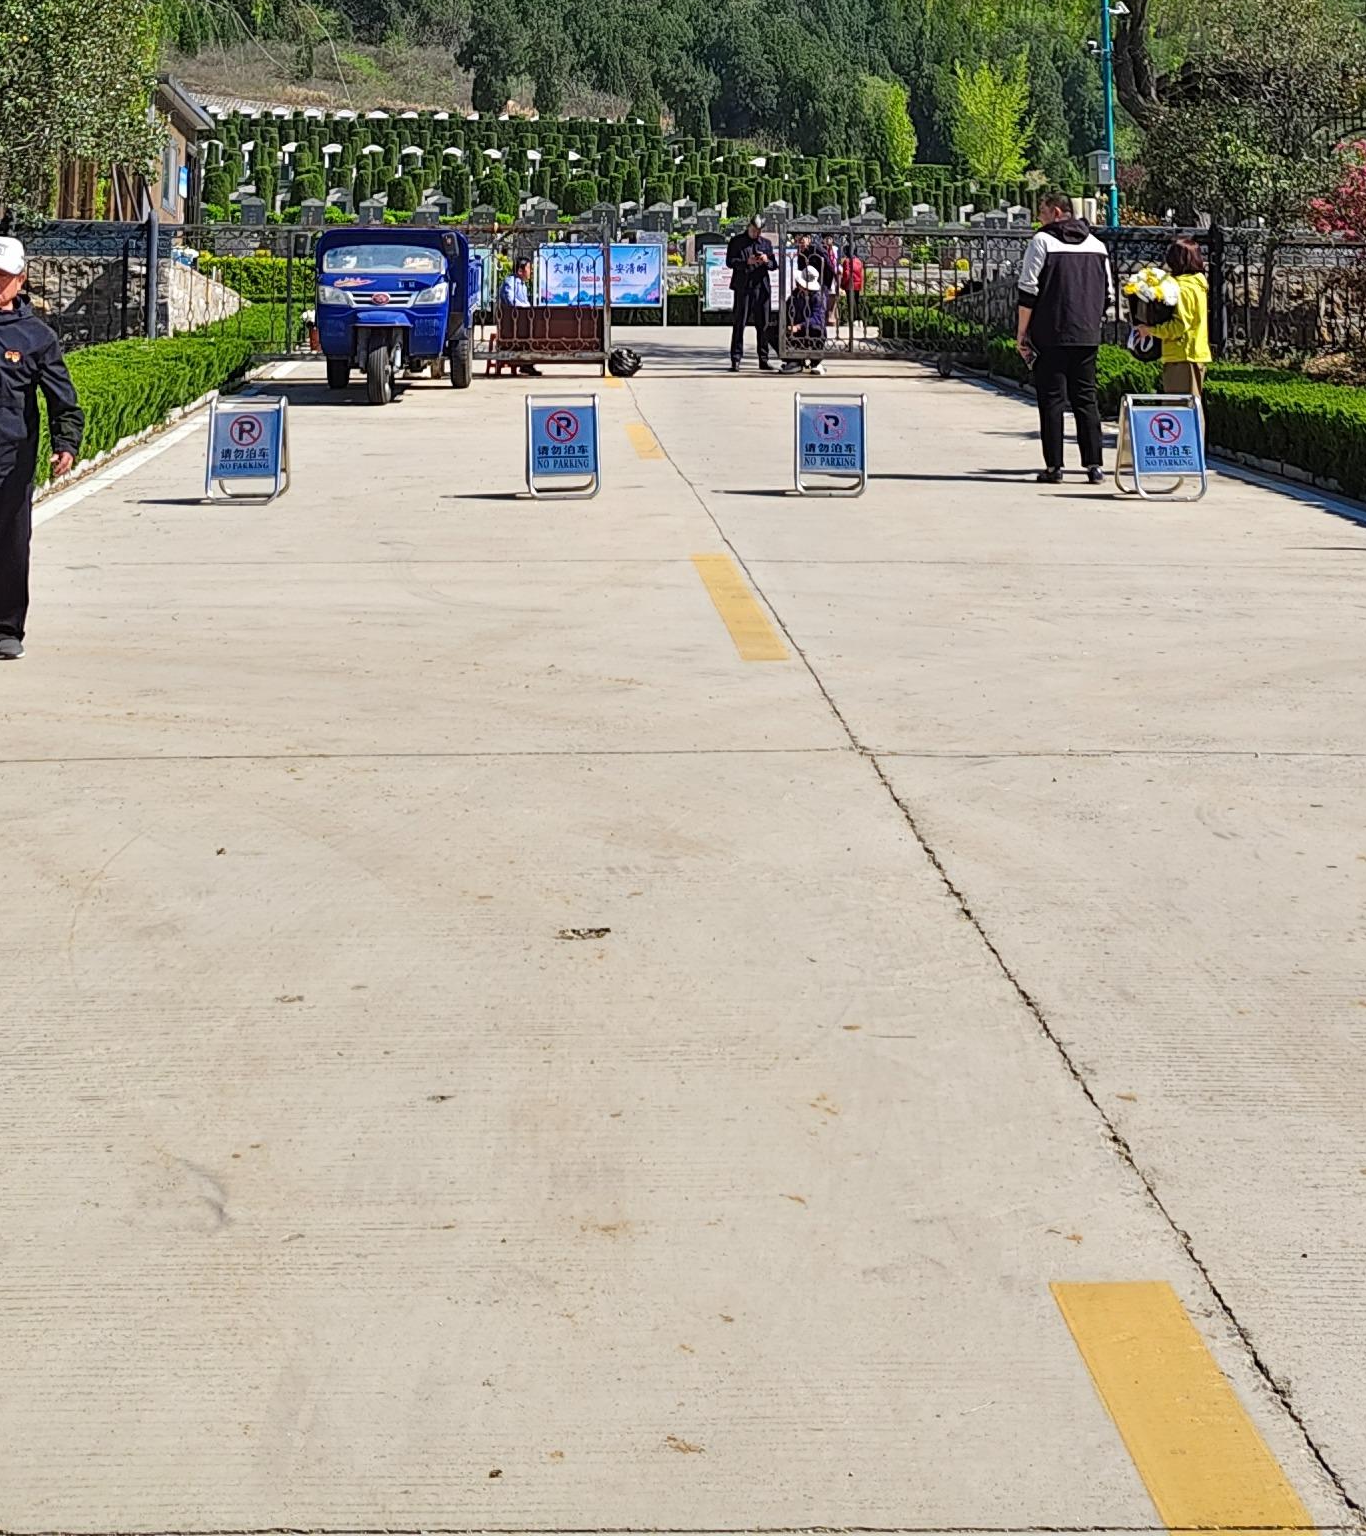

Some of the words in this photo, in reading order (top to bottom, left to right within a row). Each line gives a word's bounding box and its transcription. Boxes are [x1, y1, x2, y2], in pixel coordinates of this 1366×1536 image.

[537, 445, 588, 455] 请勿泊车
[805, 443, 856, 453] 请勿泊车
[1145, 445, 1192, 456] 请勿泊车
[221, 448, 269, 459] 请勿泊车
[219, 462, 231, 470] NO
[233, 461, 268, 470] PARKING
[537, 459, 549, 468] NO
[553, 459, 589, 468] PARKING
[804, 457, 816, 466] NO
[820, 457, 856, 466] PARKING
